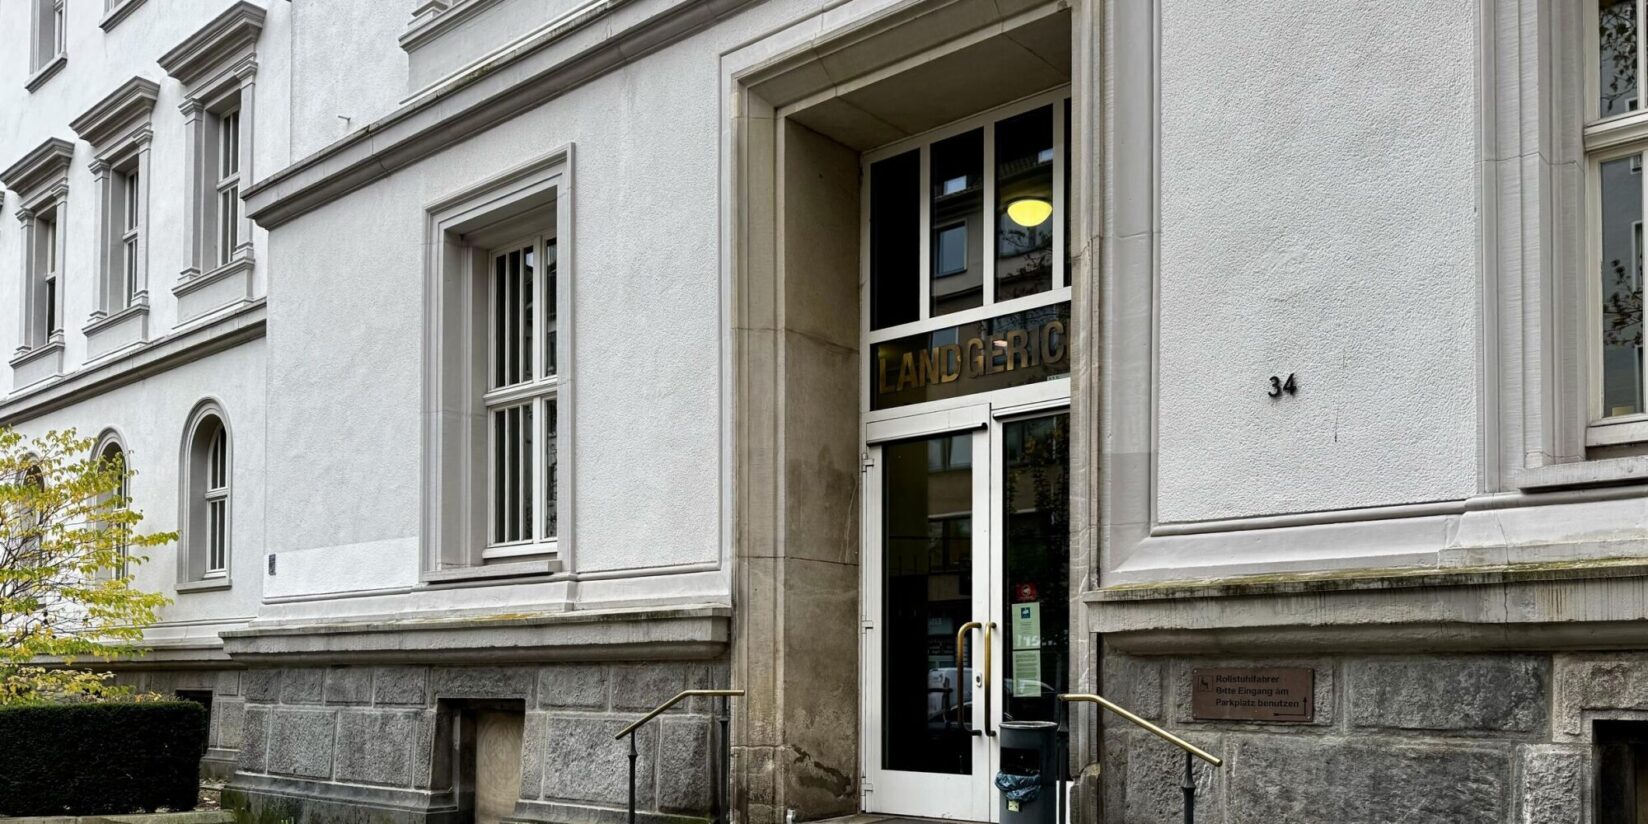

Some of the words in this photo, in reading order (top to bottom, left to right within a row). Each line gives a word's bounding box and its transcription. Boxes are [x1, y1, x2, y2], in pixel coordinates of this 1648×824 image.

[879, 319, 1071, 394] LANDGERIC
[1268, 373, 1297, 398] 34
[1216, 675, 1280, 683] Rollstuhlfahrer
[1216, 687, 1236, 695] Bitte
[1238, 687, 1273, 696] Eingang
[1216, 699, 1255, 708] Parkplatz
[1258, 699, 1299, 708] benutzen
